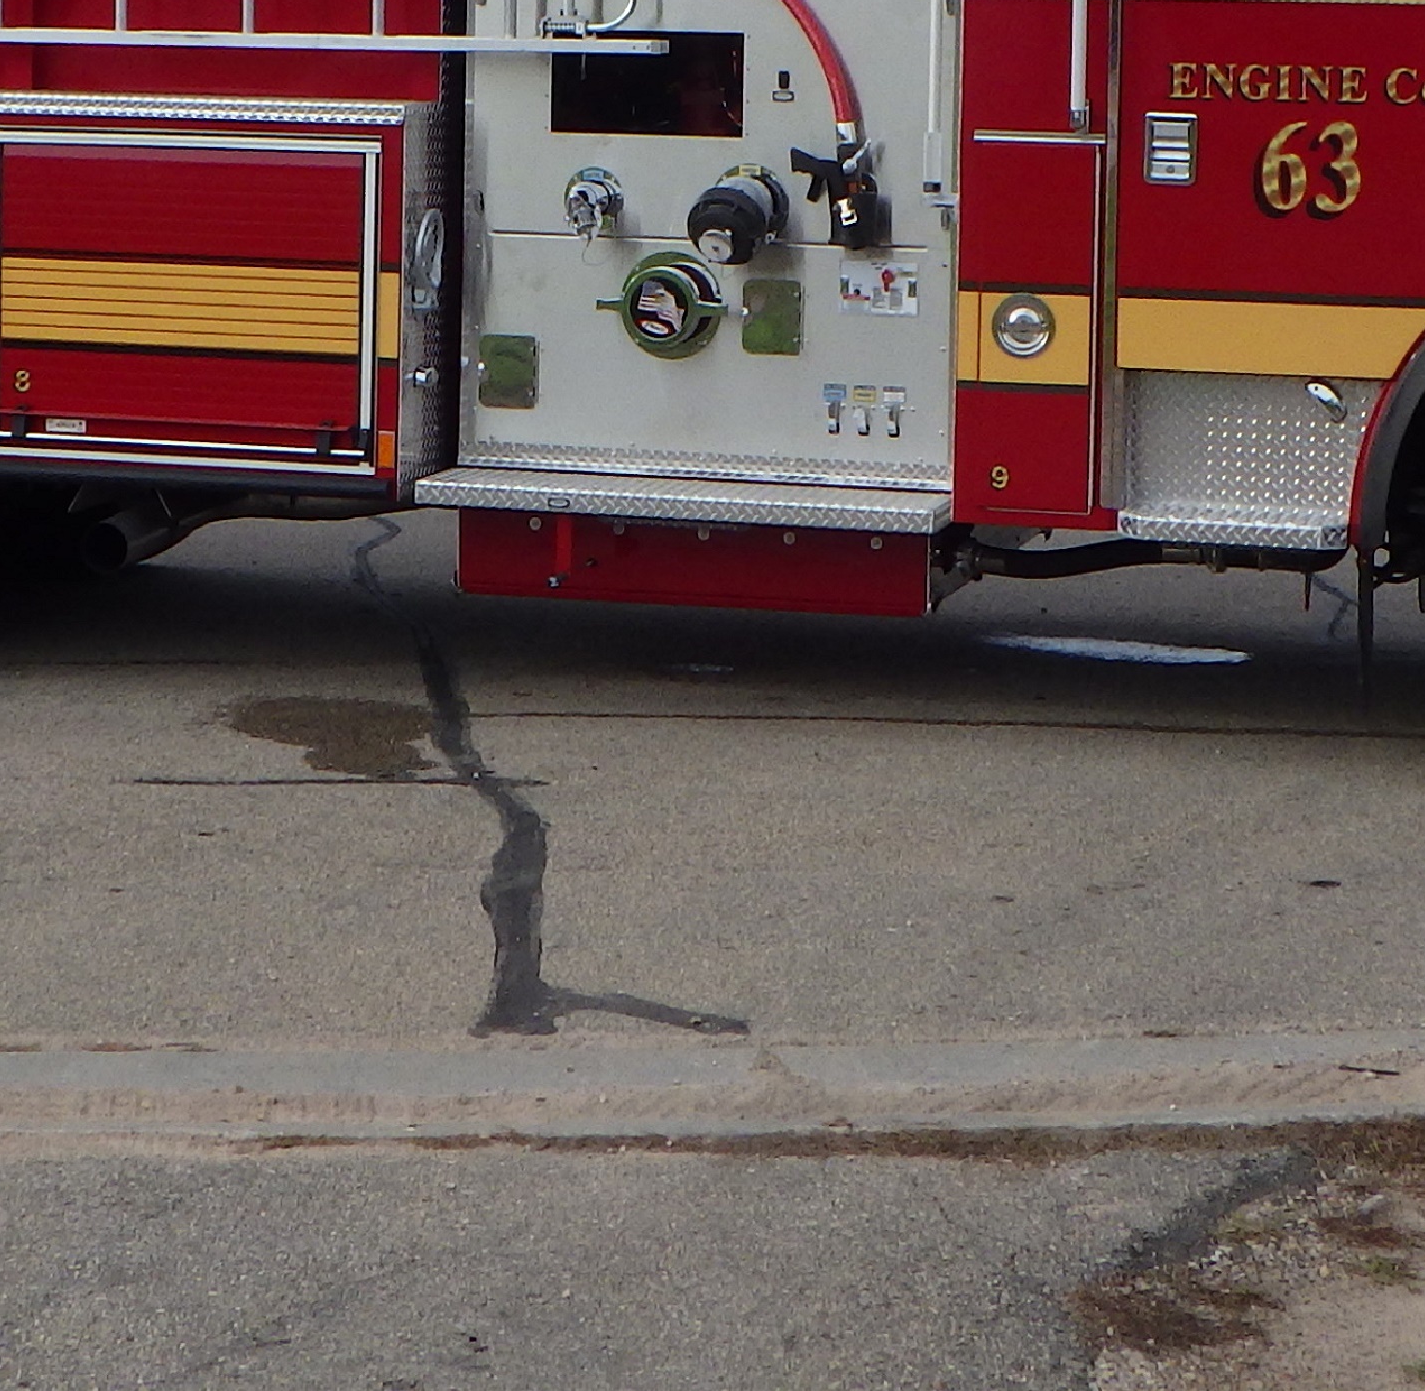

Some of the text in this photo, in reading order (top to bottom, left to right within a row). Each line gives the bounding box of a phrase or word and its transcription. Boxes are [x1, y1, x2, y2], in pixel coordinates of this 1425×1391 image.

[1169, 62, 1368, 104] ENGINE
[1254, 121, 1362, 218] 63
[15, 370, 31, 392] 8
[991, 466, 1009, 489] 9
